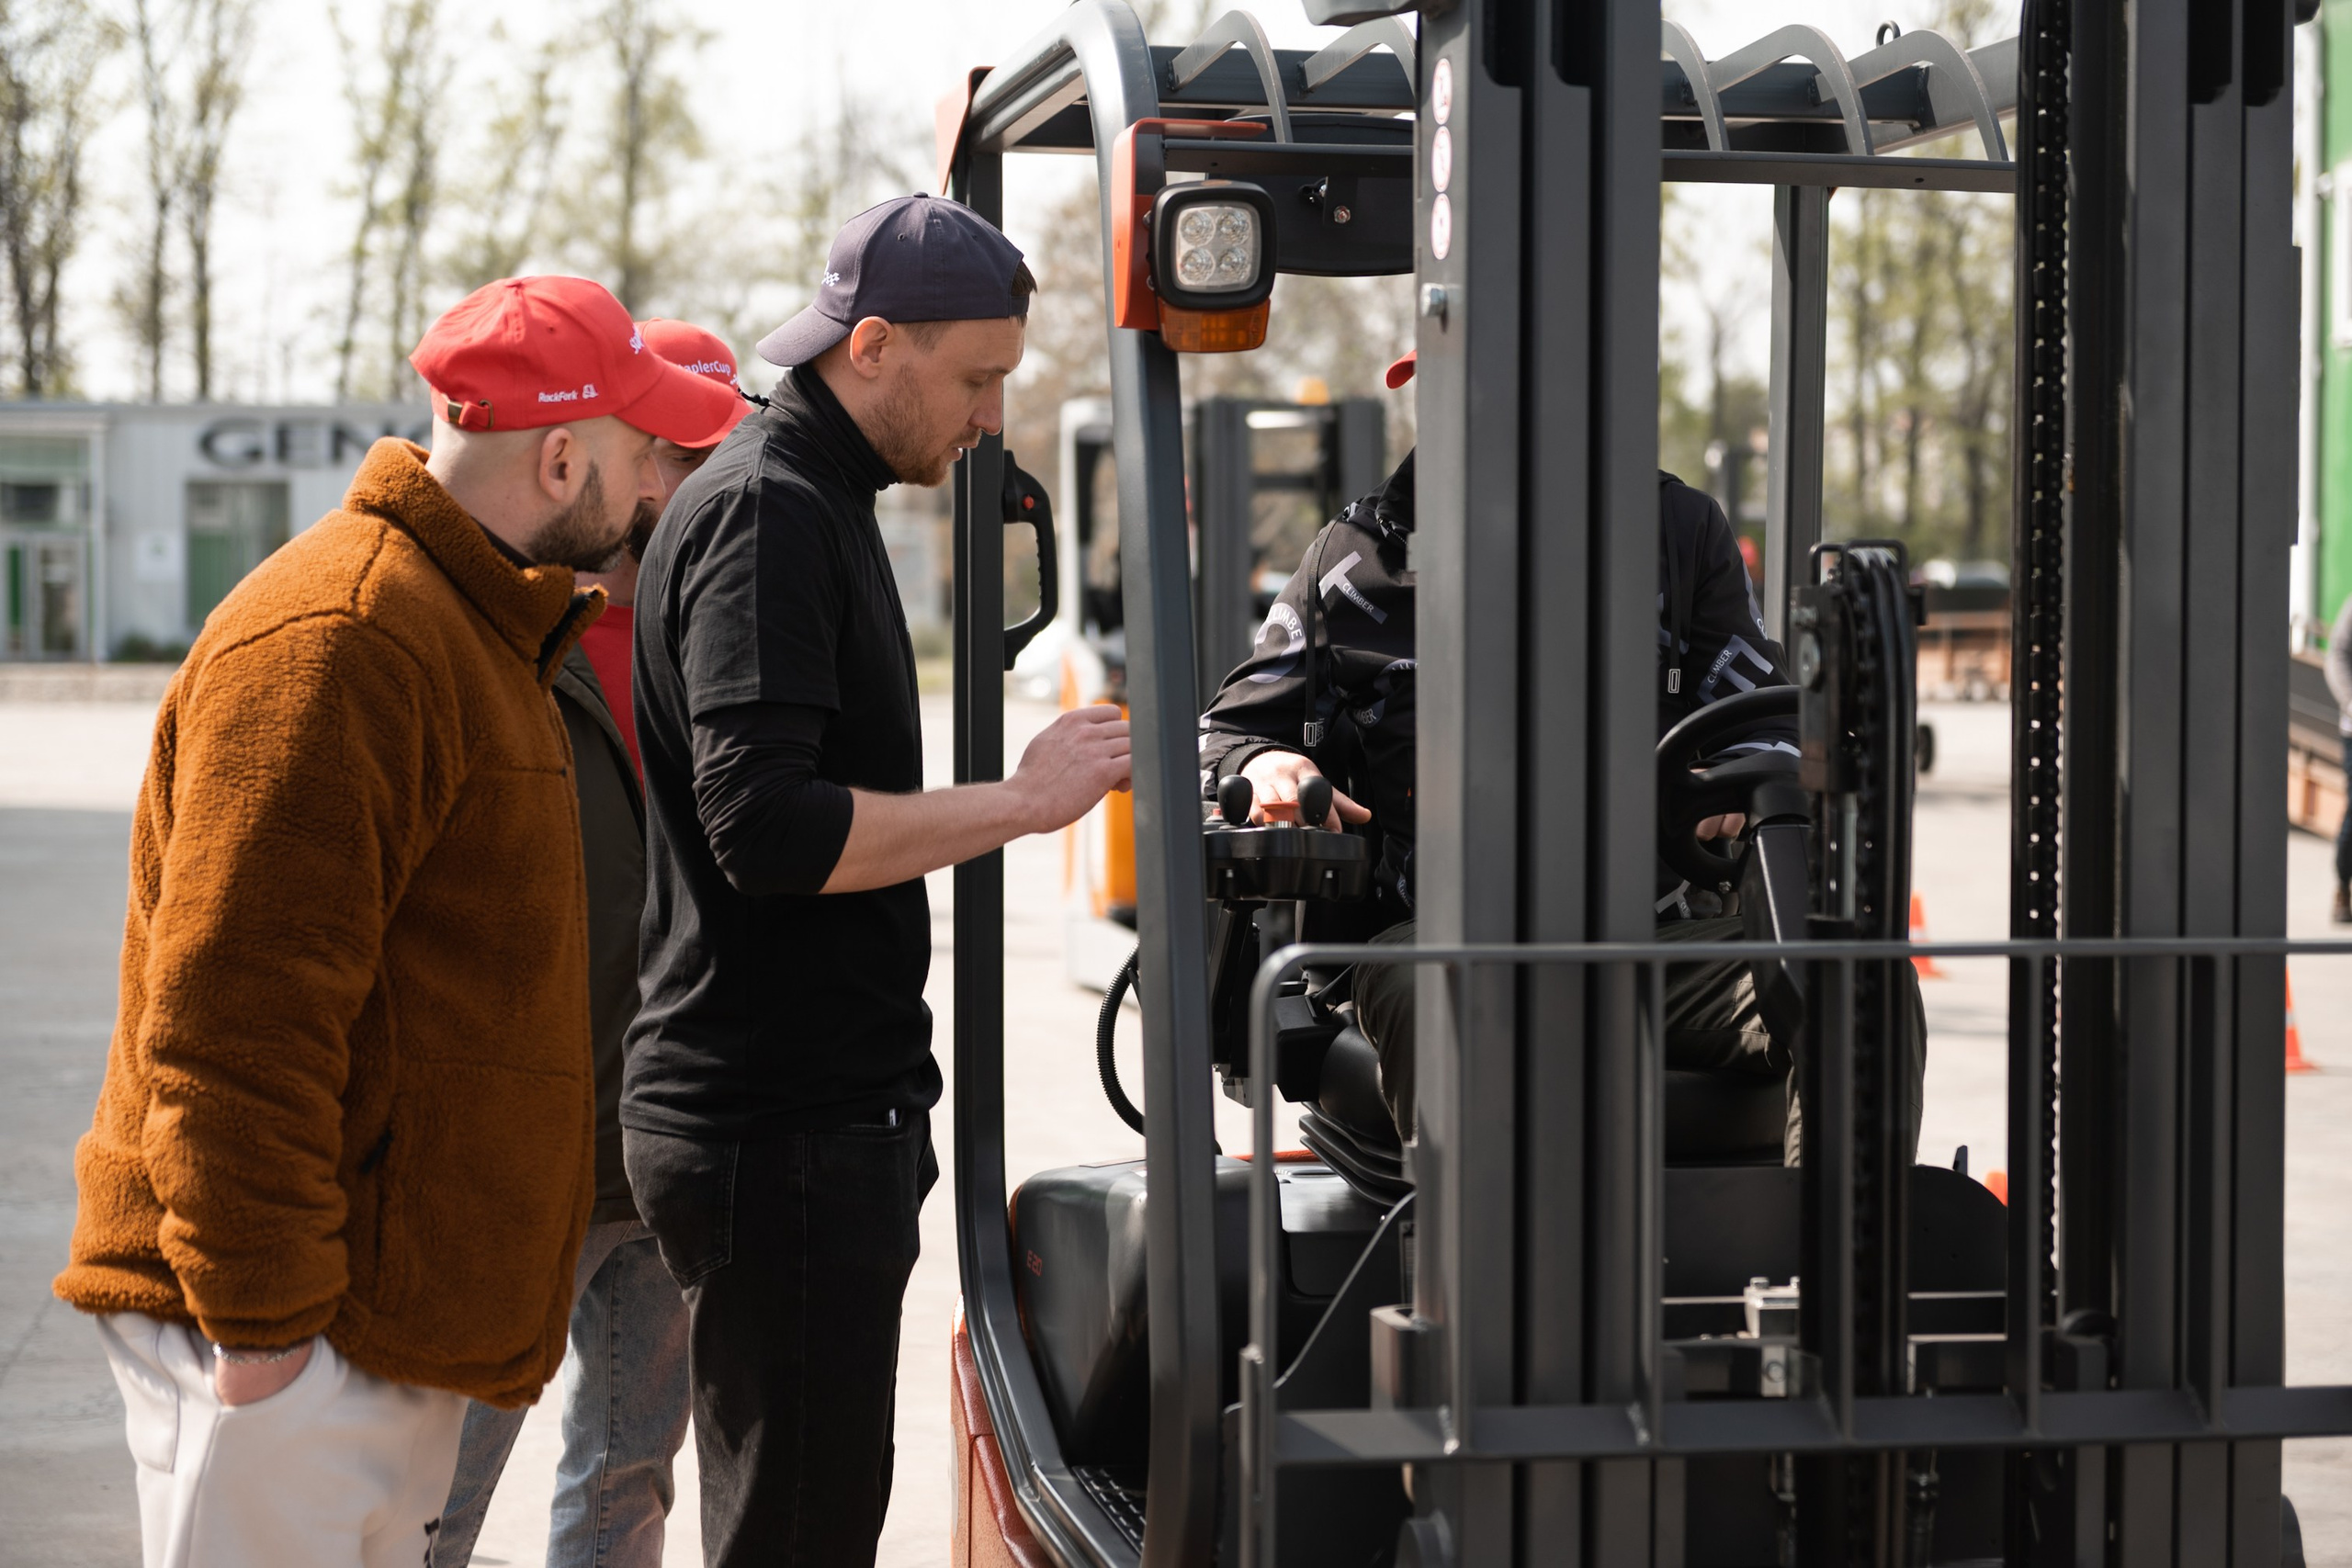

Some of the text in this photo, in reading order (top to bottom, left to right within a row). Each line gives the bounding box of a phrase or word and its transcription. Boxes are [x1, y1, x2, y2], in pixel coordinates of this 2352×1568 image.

[678, 360, 731, 377] aplerCup
[1341, 581, 1374, 614] CLIMBER
[1266, 606, 1303, 640] CLIMBE
[1707, 649, 1733, 684] CLIMBER
